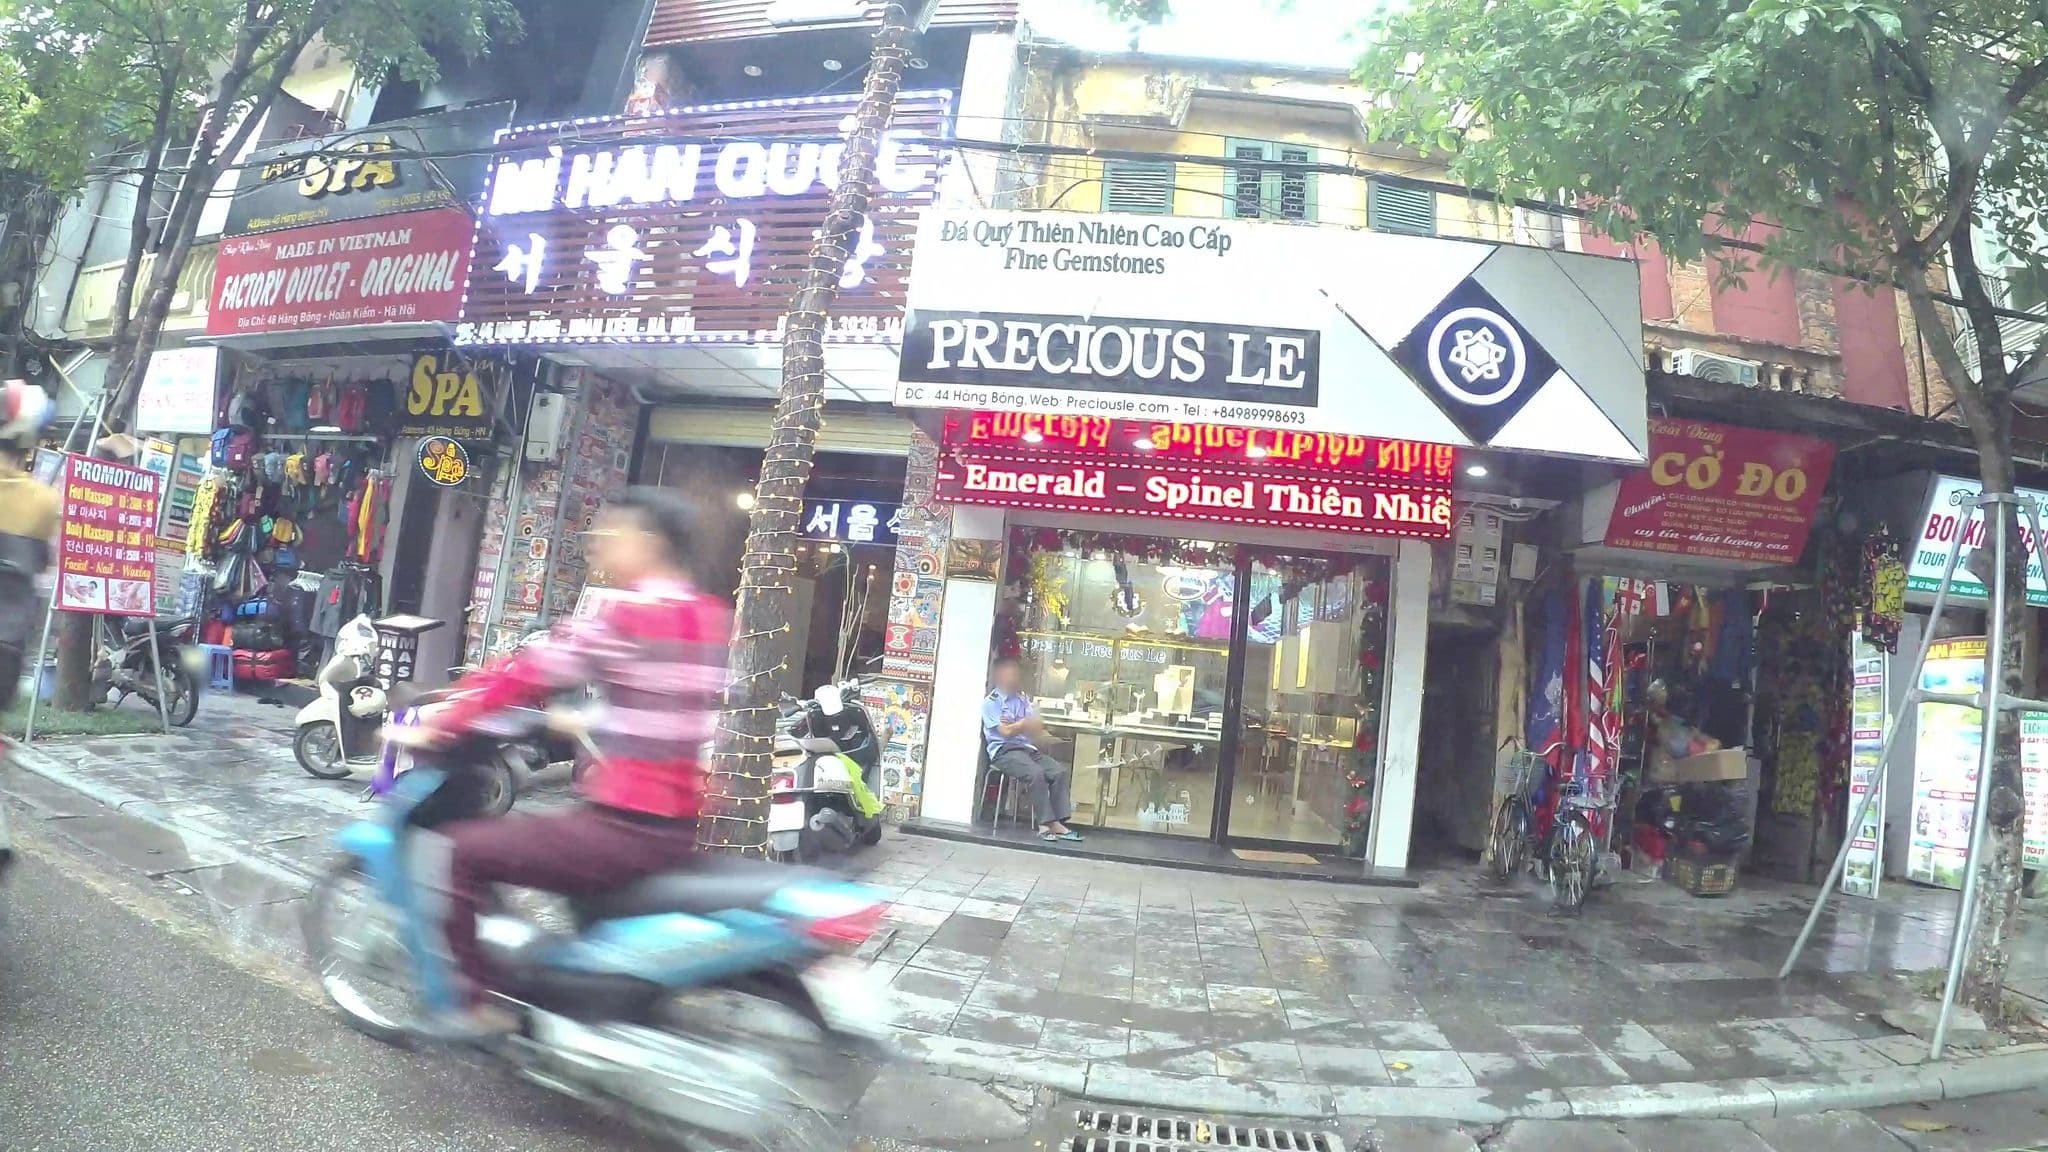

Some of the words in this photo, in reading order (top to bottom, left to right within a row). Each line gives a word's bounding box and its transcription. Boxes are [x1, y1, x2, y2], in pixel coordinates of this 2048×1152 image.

[299, 135, 396, 197] SPA
[275, 241, 315, 261] MADE
[318, 238, 336, 256] IN
[339, 227, 412, 252] VIETNAM
[941, 219, 968, 242] Đá
[973, 220, 1013, 247] Quý
[1017, 220, 1075, 244] Thiên
[1078, 222, 1140, 247] Nhiên
[1142, 223, 1185, 249] Cao
[1188, 222, 1232, 257] Cấp
[1003, 248, 1049, 271] Fine
[1052, 248, 1166, 275] Gemstones
[218, 267, 287, 311] FACTORY
[285, 260, 351, 305] OUTLET
[360, 249, 460, 299] ORIGINAL
[384, 304, 398, 317] Hà
[926, 318, 1206, 384] PRECIOUS
[1225, 331, 1306, 389] LE
[407, 354, 483, 416] SPA
[934, 388, 951, 402] 44
[1183, 404, 1202, 417] Tel
[1212, 407, 1306, 425] +84989998693
[73, 459, 154, 493] PROMOTION
[965, 463, 1105, 499] Emerald
[1145, 478, 1254, 511] Spinel
[1264, 483, 1362, 519] Thiên
[79, 507, 107, 521] 마사지
[84, 486, 114, 508] Massage
[64, 539, 84, 554] 전신
[85, 543, 113, 558] 마사지
[1634, 527, 1656, 540] uy
[1766, 542, 1790, 552] cao
[1918, 550, 1947, 567] TOUR
